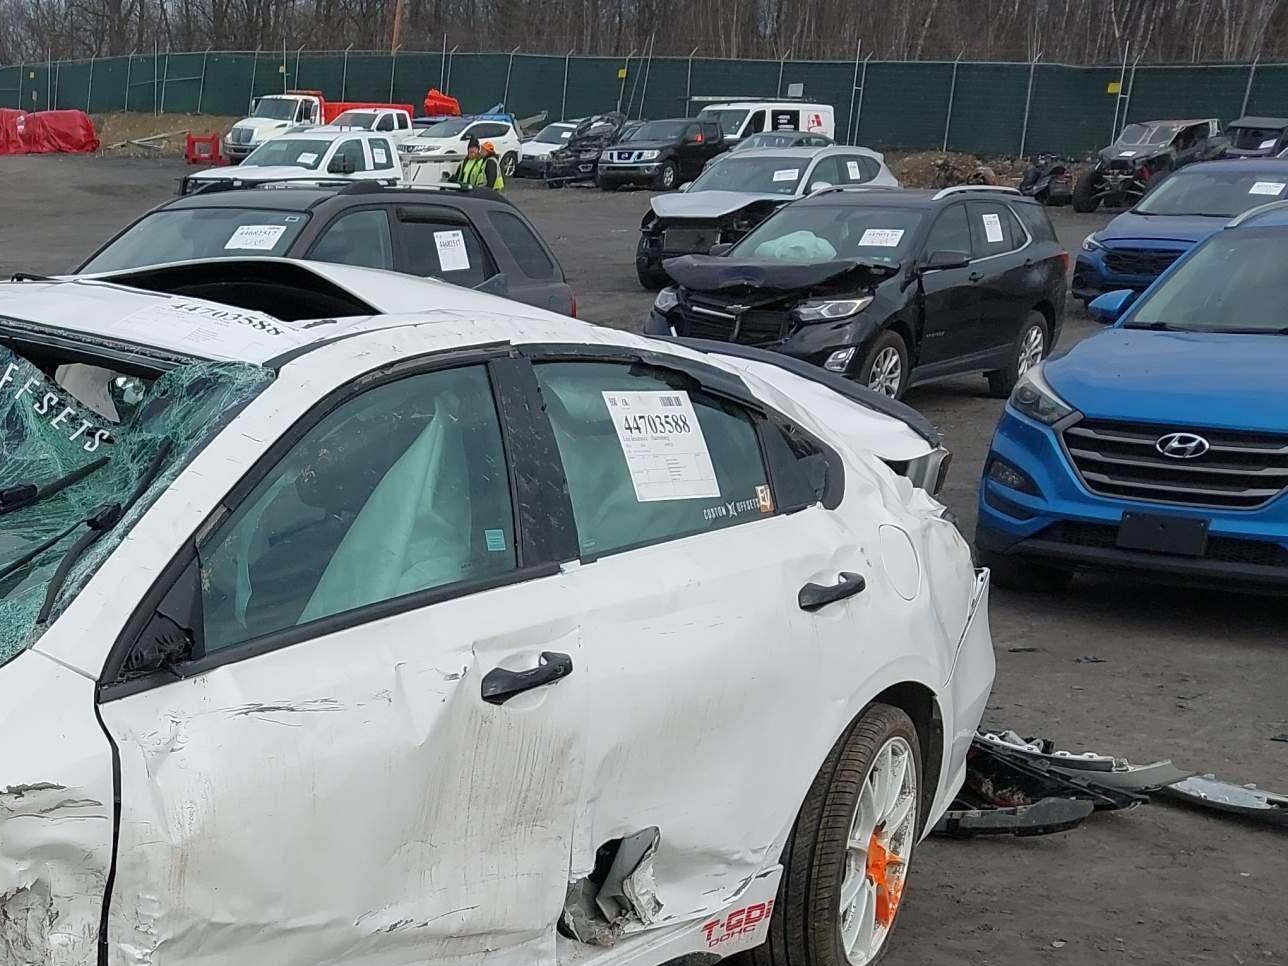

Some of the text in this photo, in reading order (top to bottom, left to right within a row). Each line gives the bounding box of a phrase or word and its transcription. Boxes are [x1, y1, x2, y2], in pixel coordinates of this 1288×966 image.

[170, 302, 285, 337] 44703588
[623, 414, 691, 434] 44703588
[708, 924, 757, 948] DOHC
